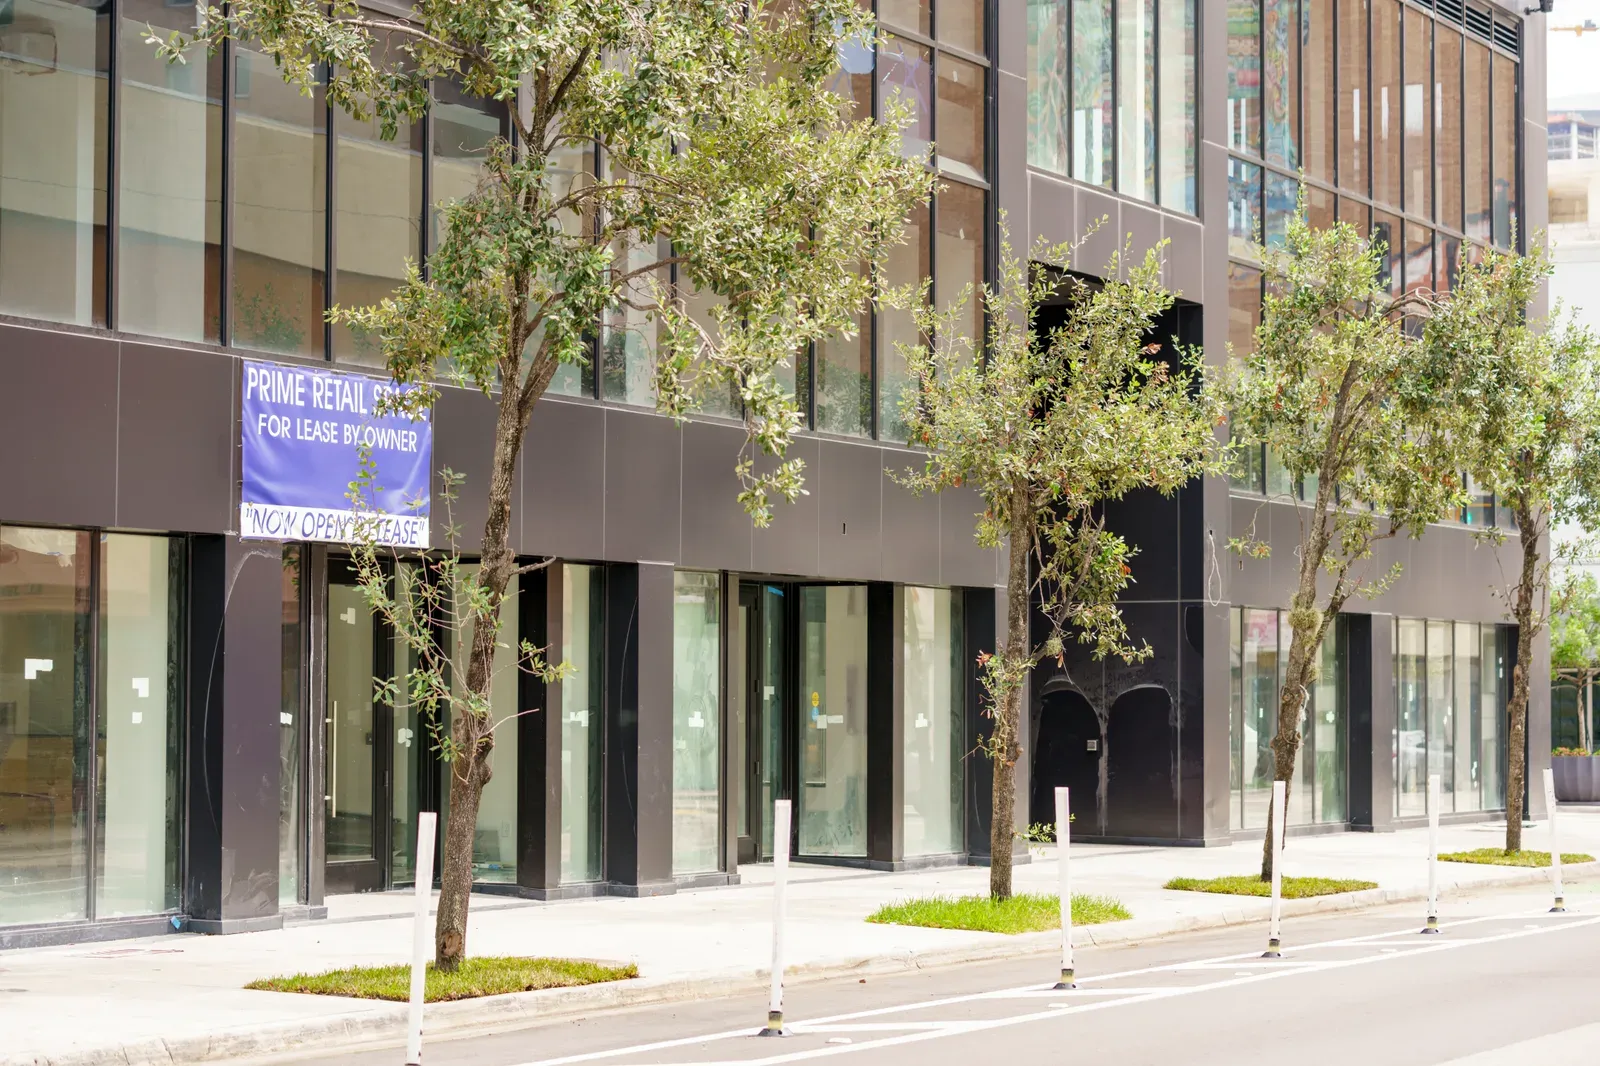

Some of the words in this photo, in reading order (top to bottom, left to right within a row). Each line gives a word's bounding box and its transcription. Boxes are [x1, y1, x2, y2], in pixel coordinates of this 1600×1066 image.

[247, 367, 305, 407] PRIME
[312, 376, 368, 414] RETAIL
[258, 413, 291, 439] FOR
[296, 418, 338, 444] LEASE
[343, 423, 361, 446] BY
[364, 426, 417, 453] OWNER
[301, 511, 347, 540] OPEN
